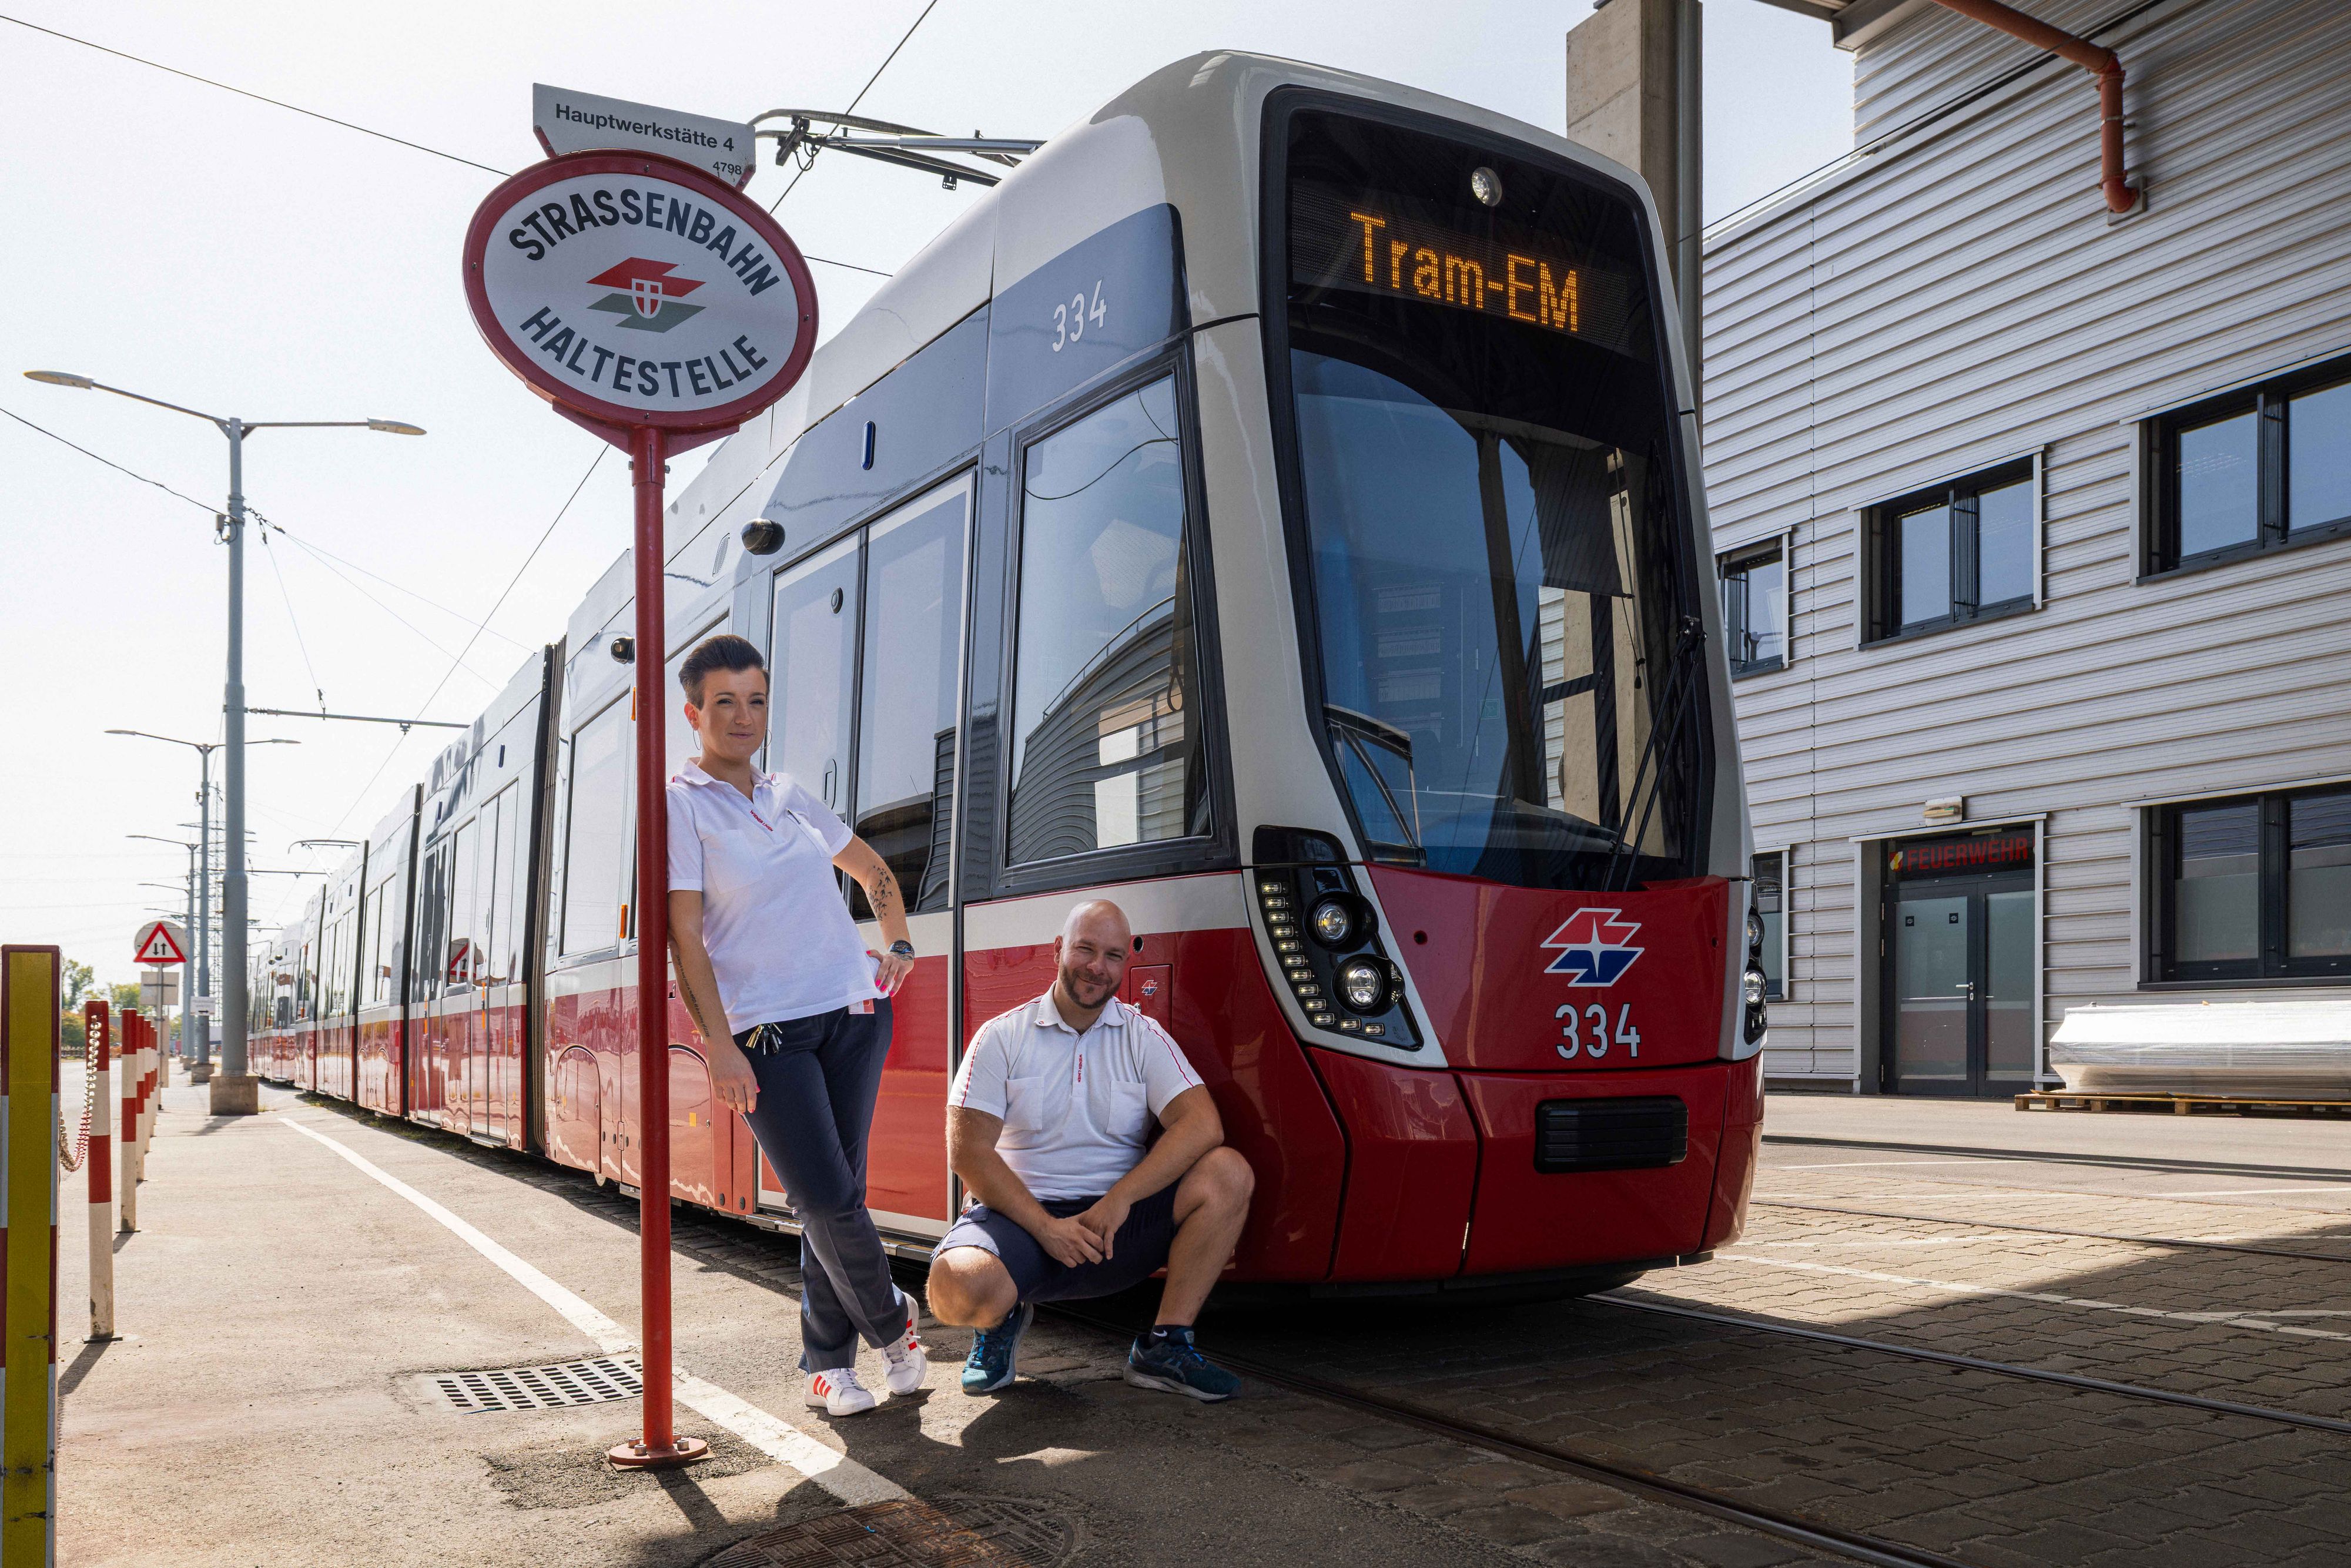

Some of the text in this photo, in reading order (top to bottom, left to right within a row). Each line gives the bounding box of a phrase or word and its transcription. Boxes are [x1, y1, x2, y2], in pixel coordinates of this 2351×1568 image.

[555, 103, 735, 152] Hauptwerkstätte 4
[712, 161, 742, 175] 4798
[509, 189, 780, 297] STRASSENBAHN
[1351, 212, 1578, 331] Tram-EM
[1052, 279, 1107, 352] 334
[520, 306, 768, 398] HALTESTELLE
[1907, 837, 2028, 872] FEUERWEHR
[1554, 1002, 1642, 1060] 334
